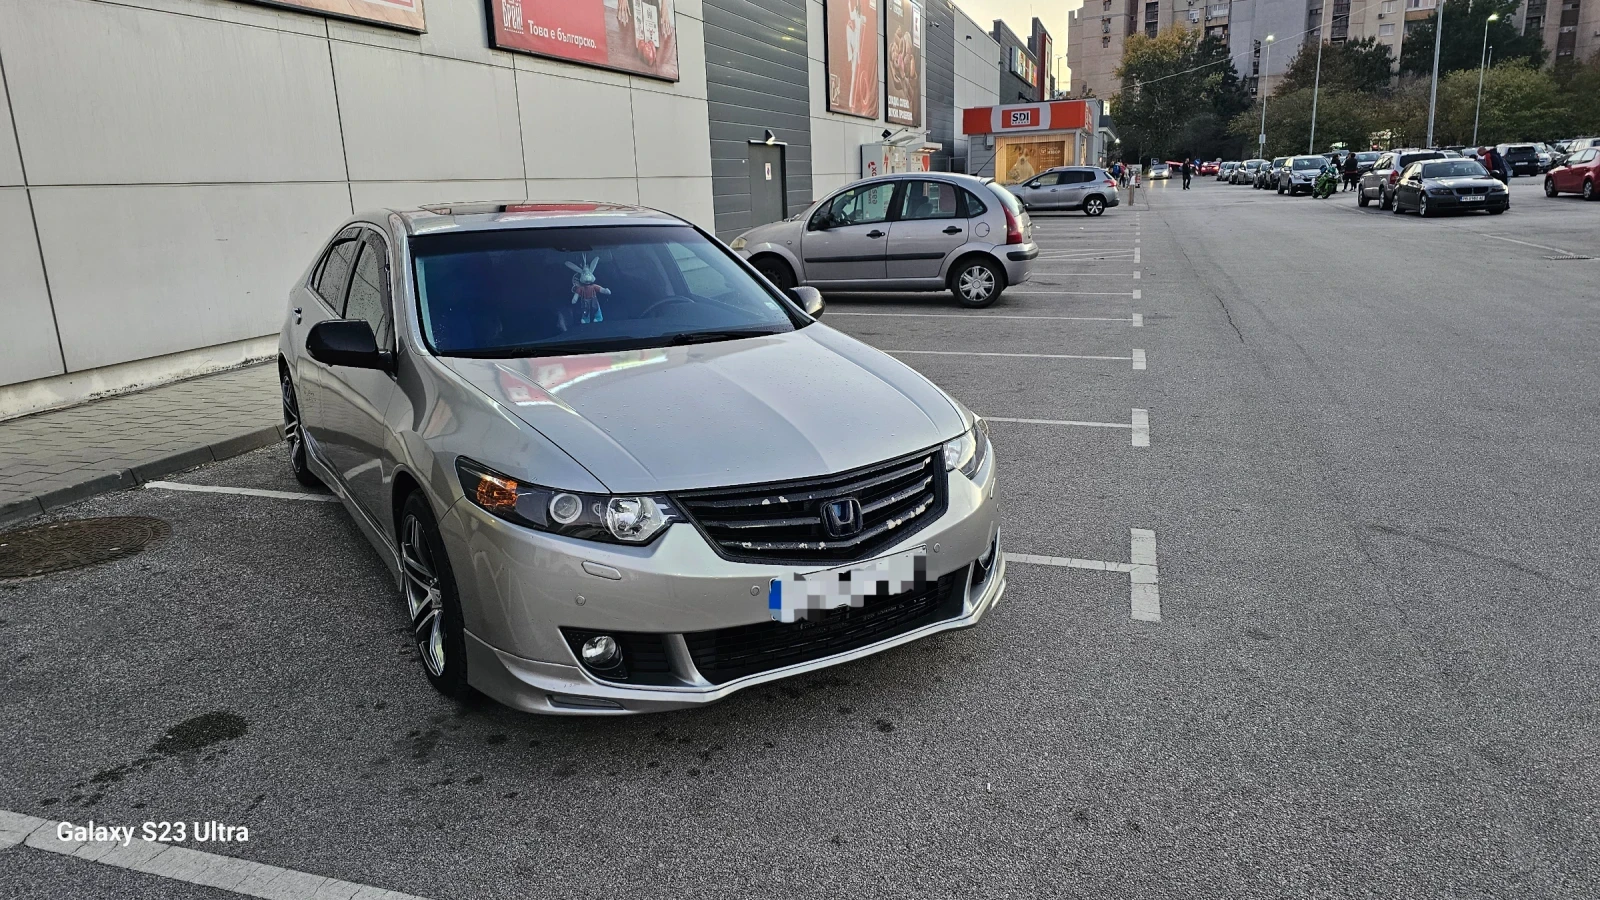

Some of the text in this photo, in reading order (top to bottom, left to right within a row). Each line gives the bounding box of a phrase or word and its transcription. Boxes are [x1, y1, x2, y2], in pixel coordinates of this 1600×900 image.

[528, 20, 597, 49] Това е българско.
[1012, 112, 1030, 122] SDI
